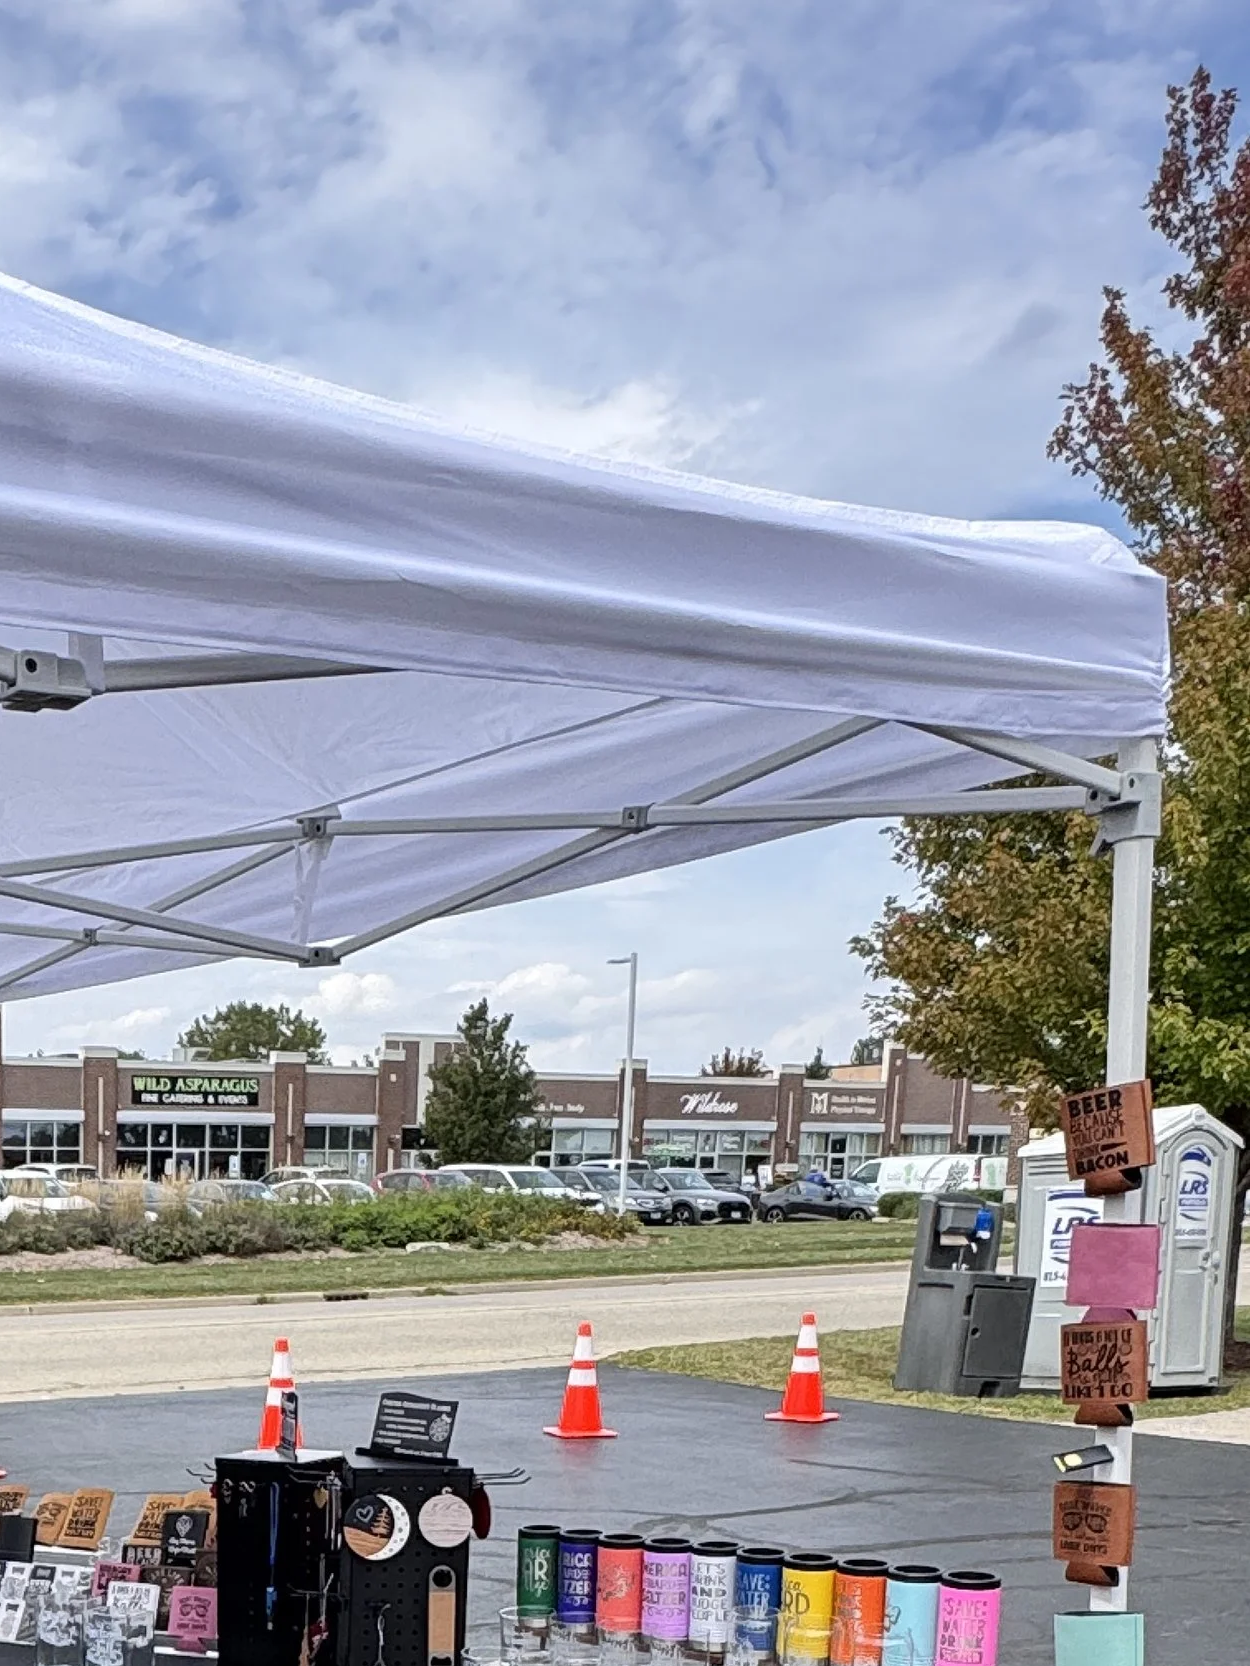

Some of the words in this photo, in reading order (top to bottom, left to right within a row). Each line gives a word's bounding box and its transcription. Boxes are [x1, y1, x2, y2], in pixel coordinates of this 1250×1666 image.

[133, 1077, 171, 1091] WILD
[175, 1078, 259, 1093] ASPARAGUS
[207, 1095, 215, 1104] &
[680, 1091, 739, 1115] Wildrose
[1068, 1089, 1123, 1119] BEER
[1070, 1108, 1123, 1134] BECAUSE
[1072, 1130, 1092, 1149] YOU
[1093, 1119, 1125, 1142] CAN'T
[1075, 1150, 1129, 1176] BACON
[1180, 1180, 1208, 1194] LRS
[1067, 1343, 1130, 1376] Balls
[1064, 1384, 1092, 1398] LIKE
[1110, 1383, 1133, 1397] DO
[692, 1586, 727, 1598] AND
[942, 1618, 986, 1636] WATER
[940, 1634, 983, 1648] DRINK
